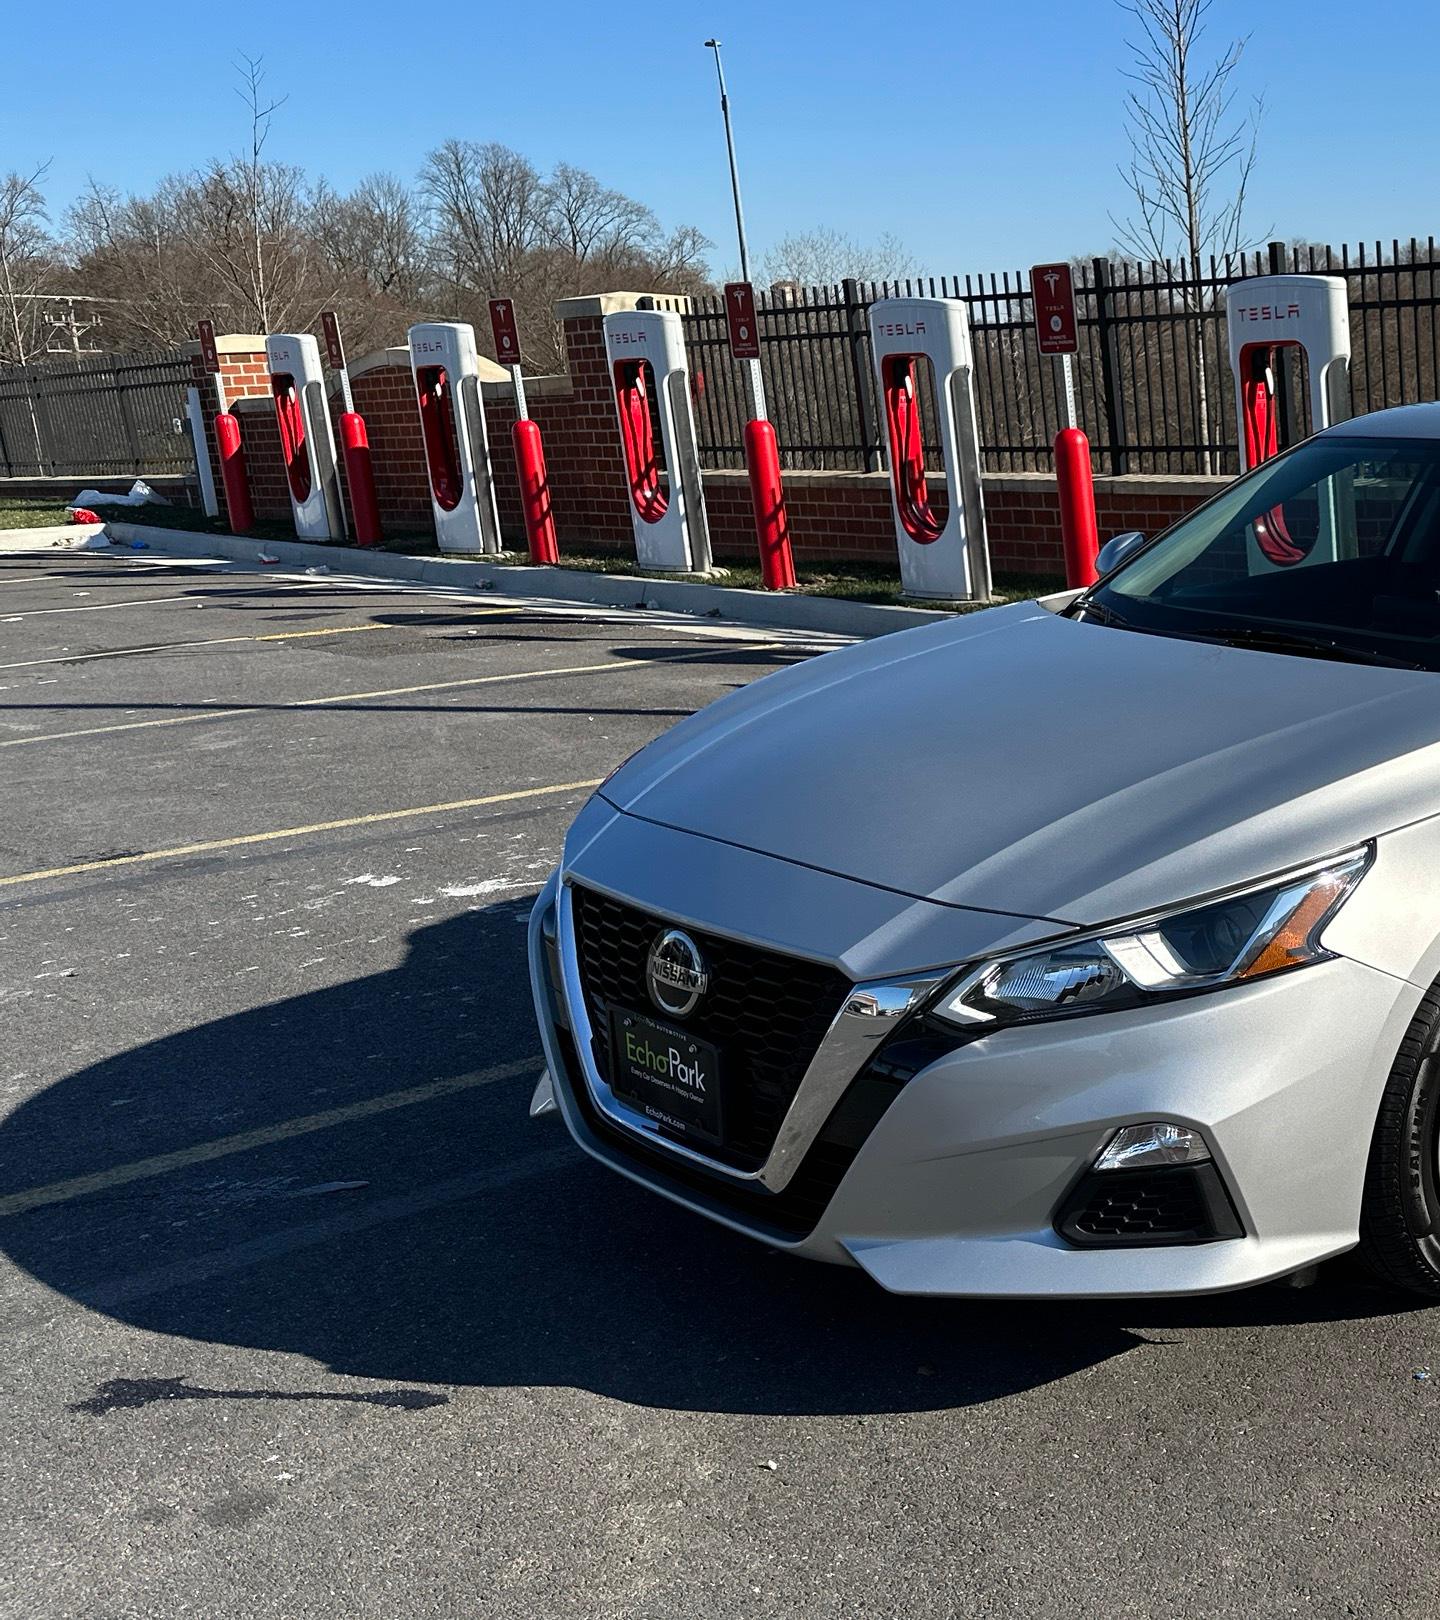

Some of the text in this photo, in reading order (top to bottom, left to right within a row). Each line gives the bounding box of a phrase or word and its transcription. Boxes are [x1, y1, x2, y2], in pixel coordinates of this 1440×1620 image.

[1238, 304, 1300, 322] TESLA
[608, 331, 647, 344] TESLA
[878, 322, 926, 337] TESLA
[411, 341, 443, 353] TESLA
[652, 960, 704, 988] NISSAN
[625, 1031, 706, 1092] EchoPark
[645, 1105, 686, 1131] EchoPark.com
